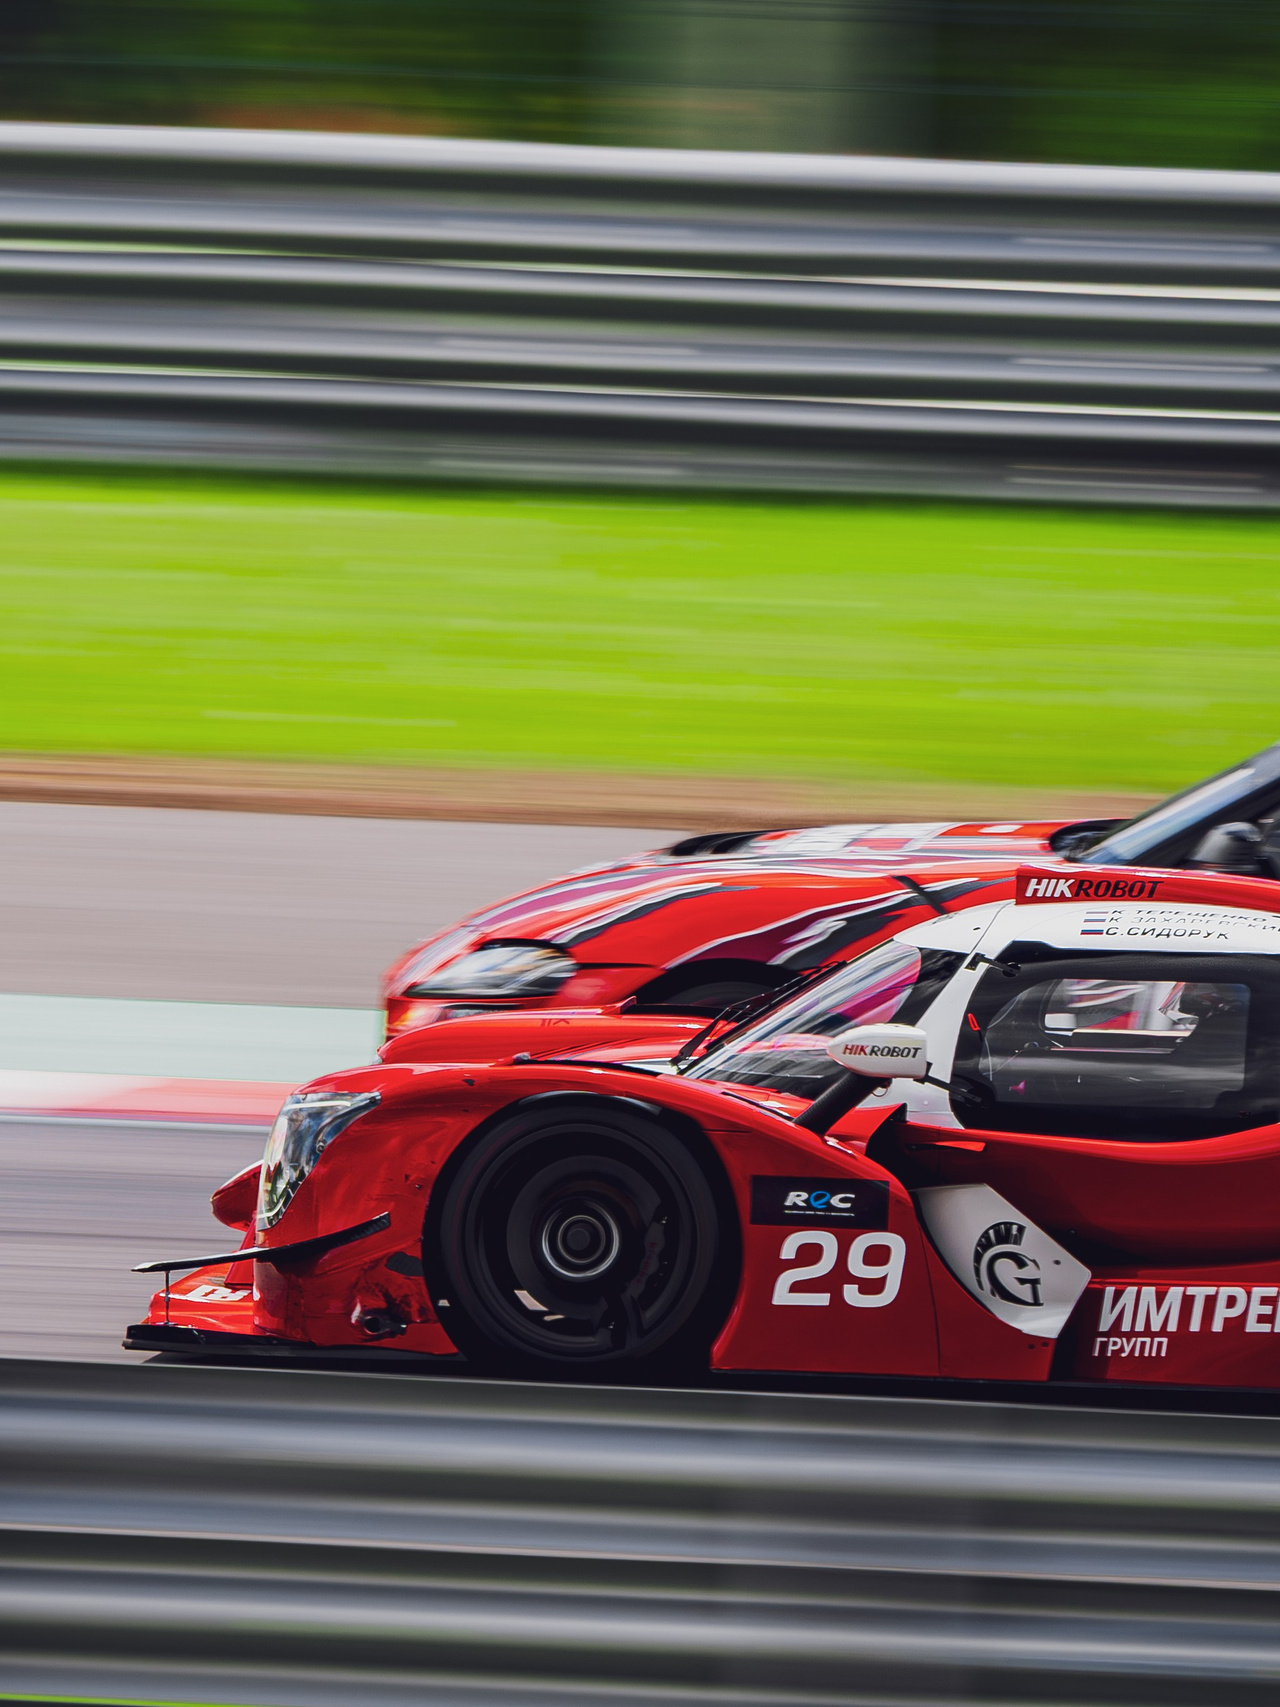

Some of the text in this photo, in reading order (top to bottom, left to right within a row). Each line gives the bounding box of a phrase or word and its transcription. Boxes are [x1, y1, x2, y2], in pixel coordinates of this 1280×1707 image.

[1024, 878, 1164, 898] HIKROBOT
[842, 1043, 922, 1059] HIKROBOT
[771, 1230, 907, 1308] 29
[1097, 1286, 1280, 1333] ИМТРЕ
[1092, 1337, 1168, 1357] ГРУПП
